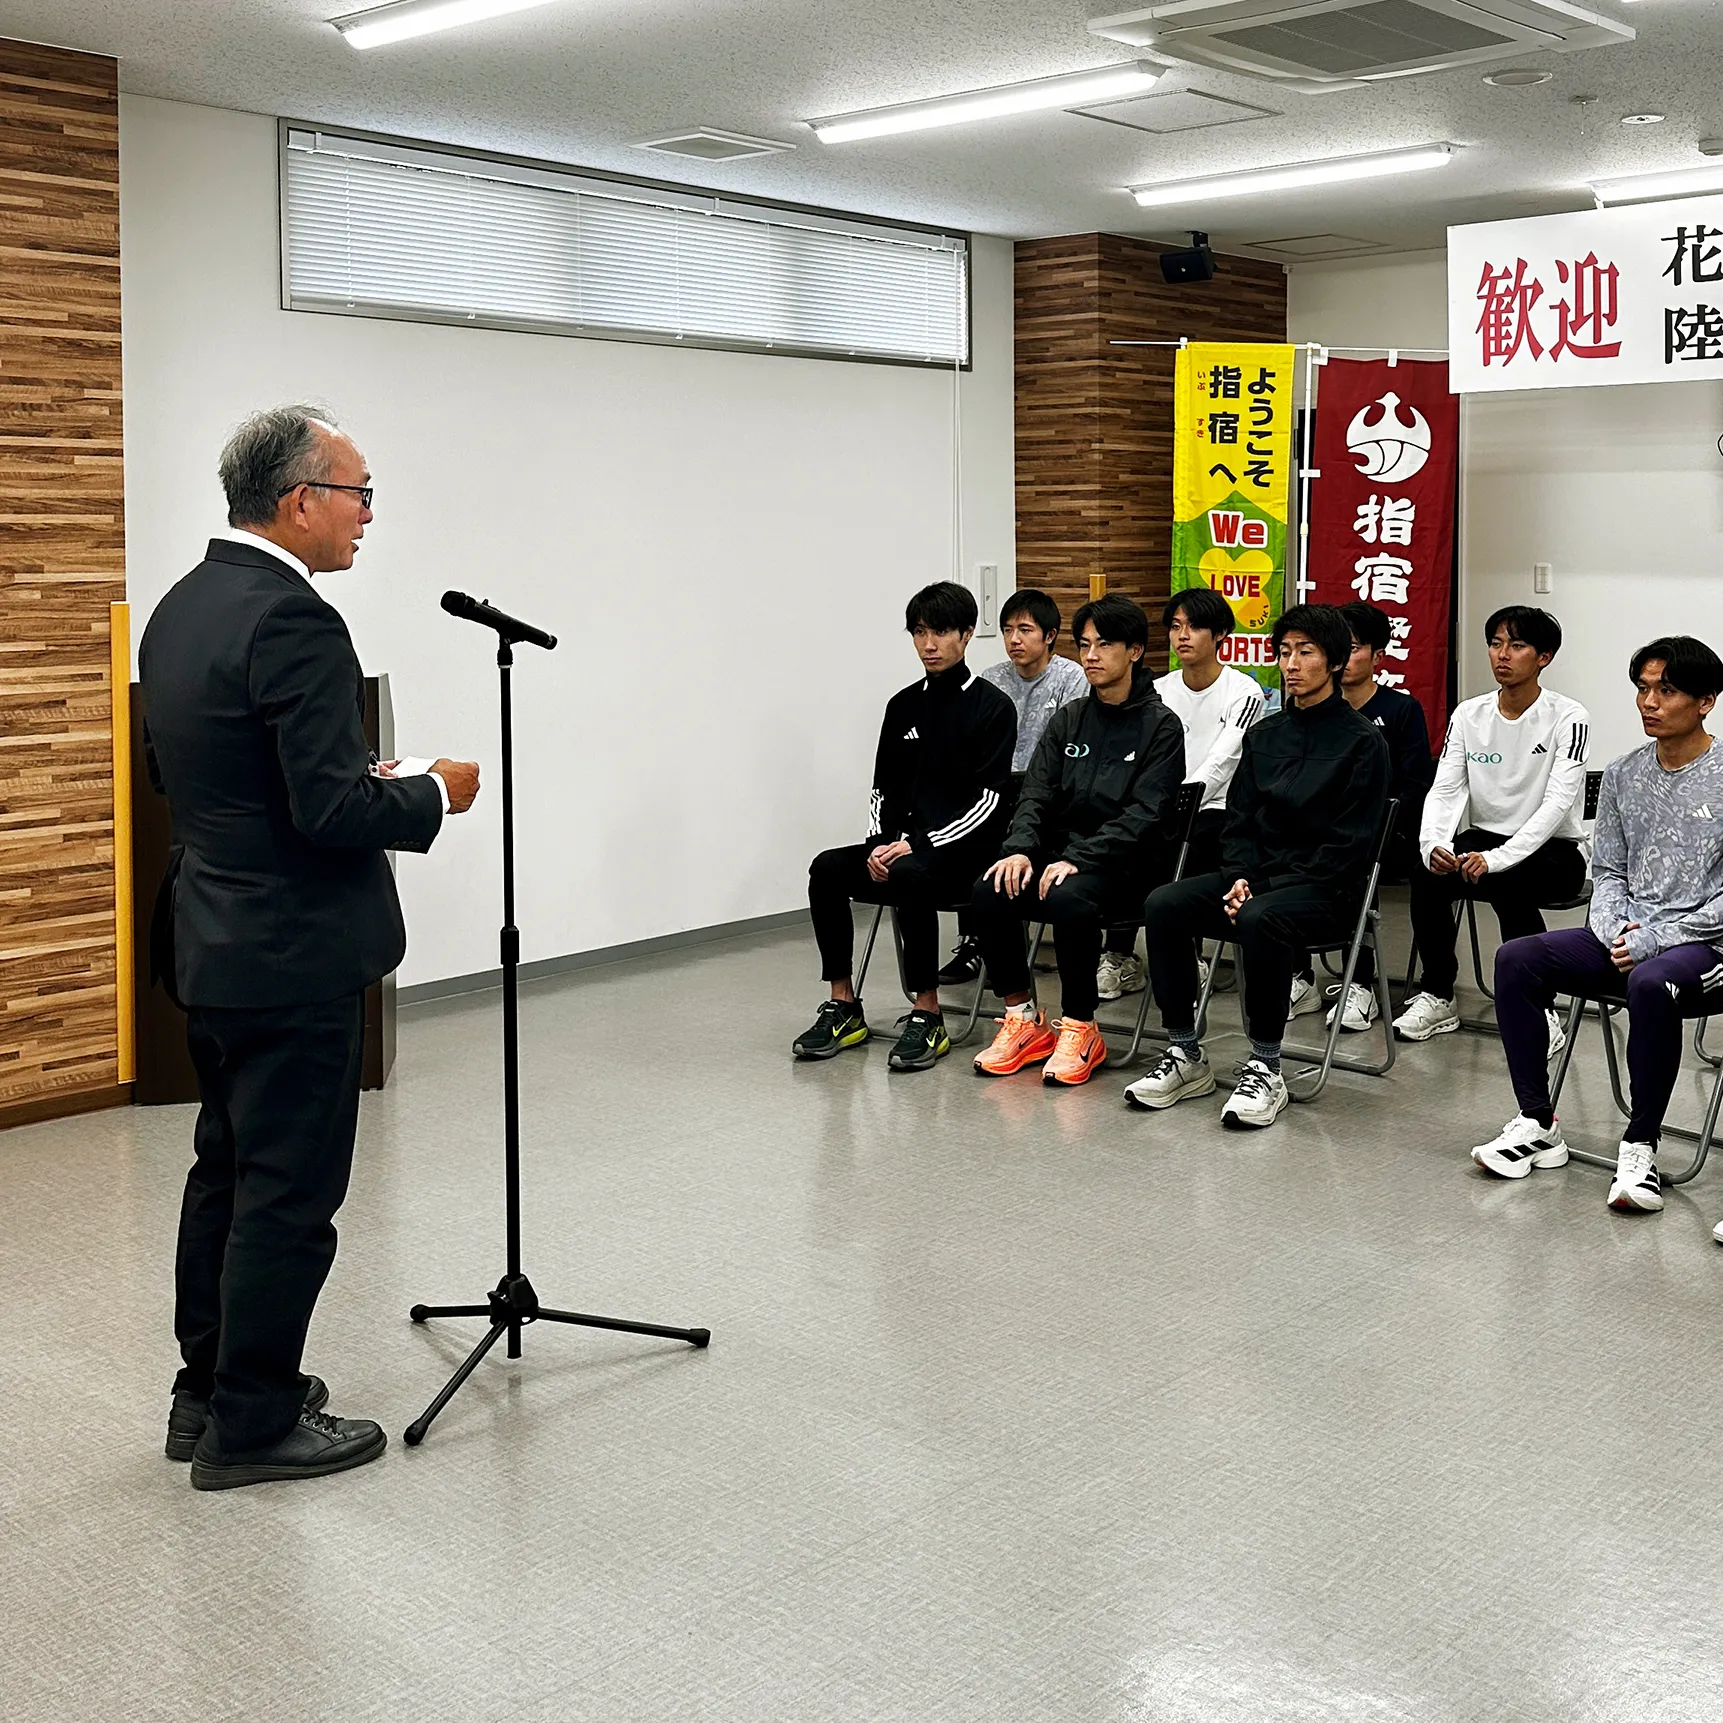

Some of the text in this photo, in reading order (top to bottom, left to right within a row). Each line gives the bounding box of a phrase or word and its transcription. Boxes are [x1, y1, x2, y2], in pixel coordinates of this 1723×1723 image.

[1661, 225, 1723, 286] 花
[1475, 251, 1622, 367] 歓迎
[1664, 304, 1723, 364] 陸
[1243, 367, 1277, 488] ようこそ
[1210, 512, 1266, 547] We
[1210, 574, 1260, 598] LOVE
[1249, 604, 1269, 628] SUKI
[1218, 635, 1276, 664] ORTS
